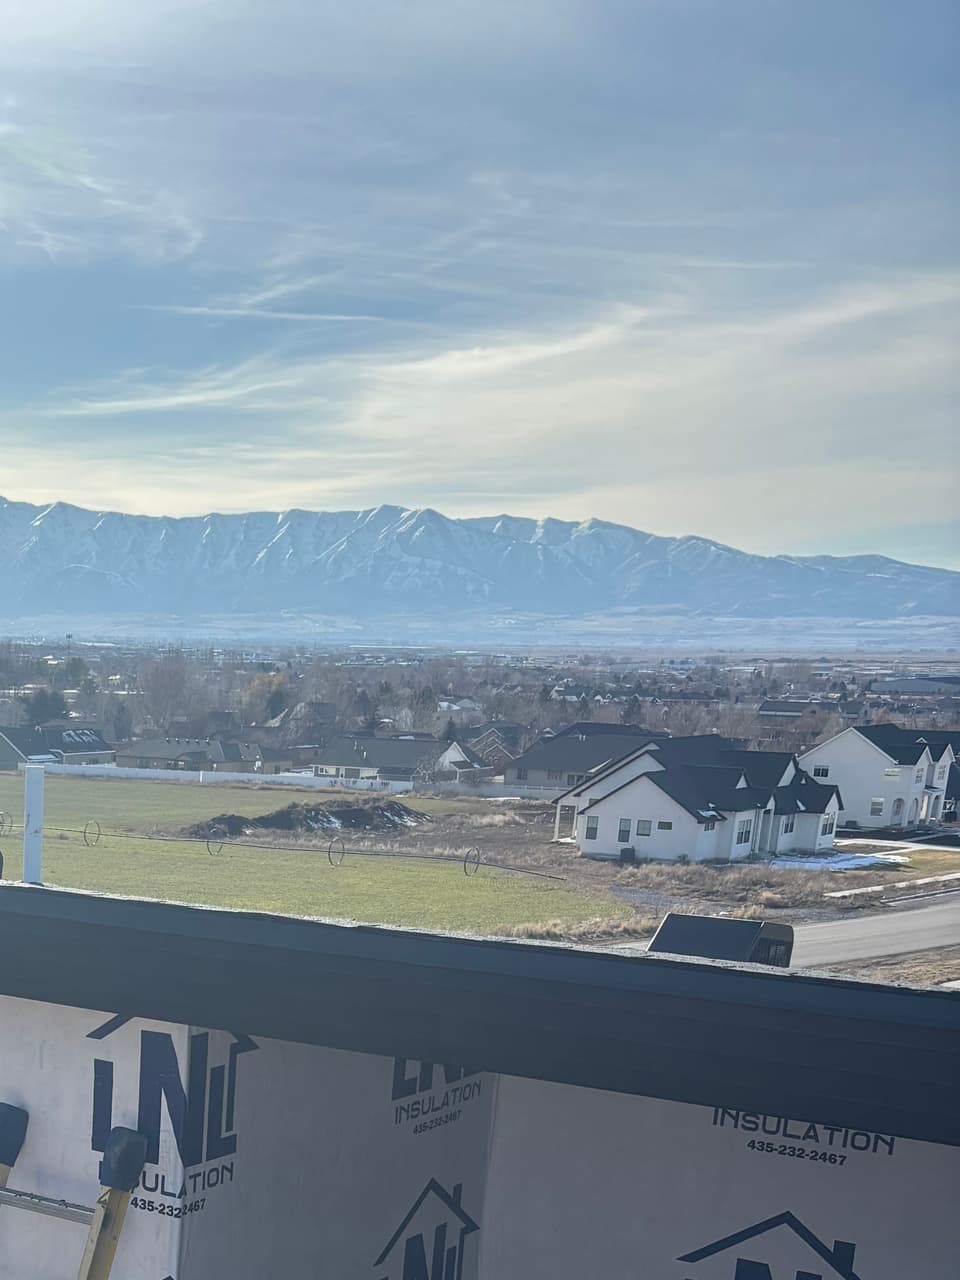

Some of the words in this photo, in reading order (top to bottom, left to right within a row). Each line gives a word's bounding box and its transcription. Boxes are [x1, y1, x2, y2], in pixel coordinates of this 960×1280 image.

[394, 1080, 482, 1125] INSULATION
[712, 1107, 895, 1156] INSULATION
[747, 1139, 847, 1166] 435-232-2467
[99, 1161, 234, 1199] ULATION
